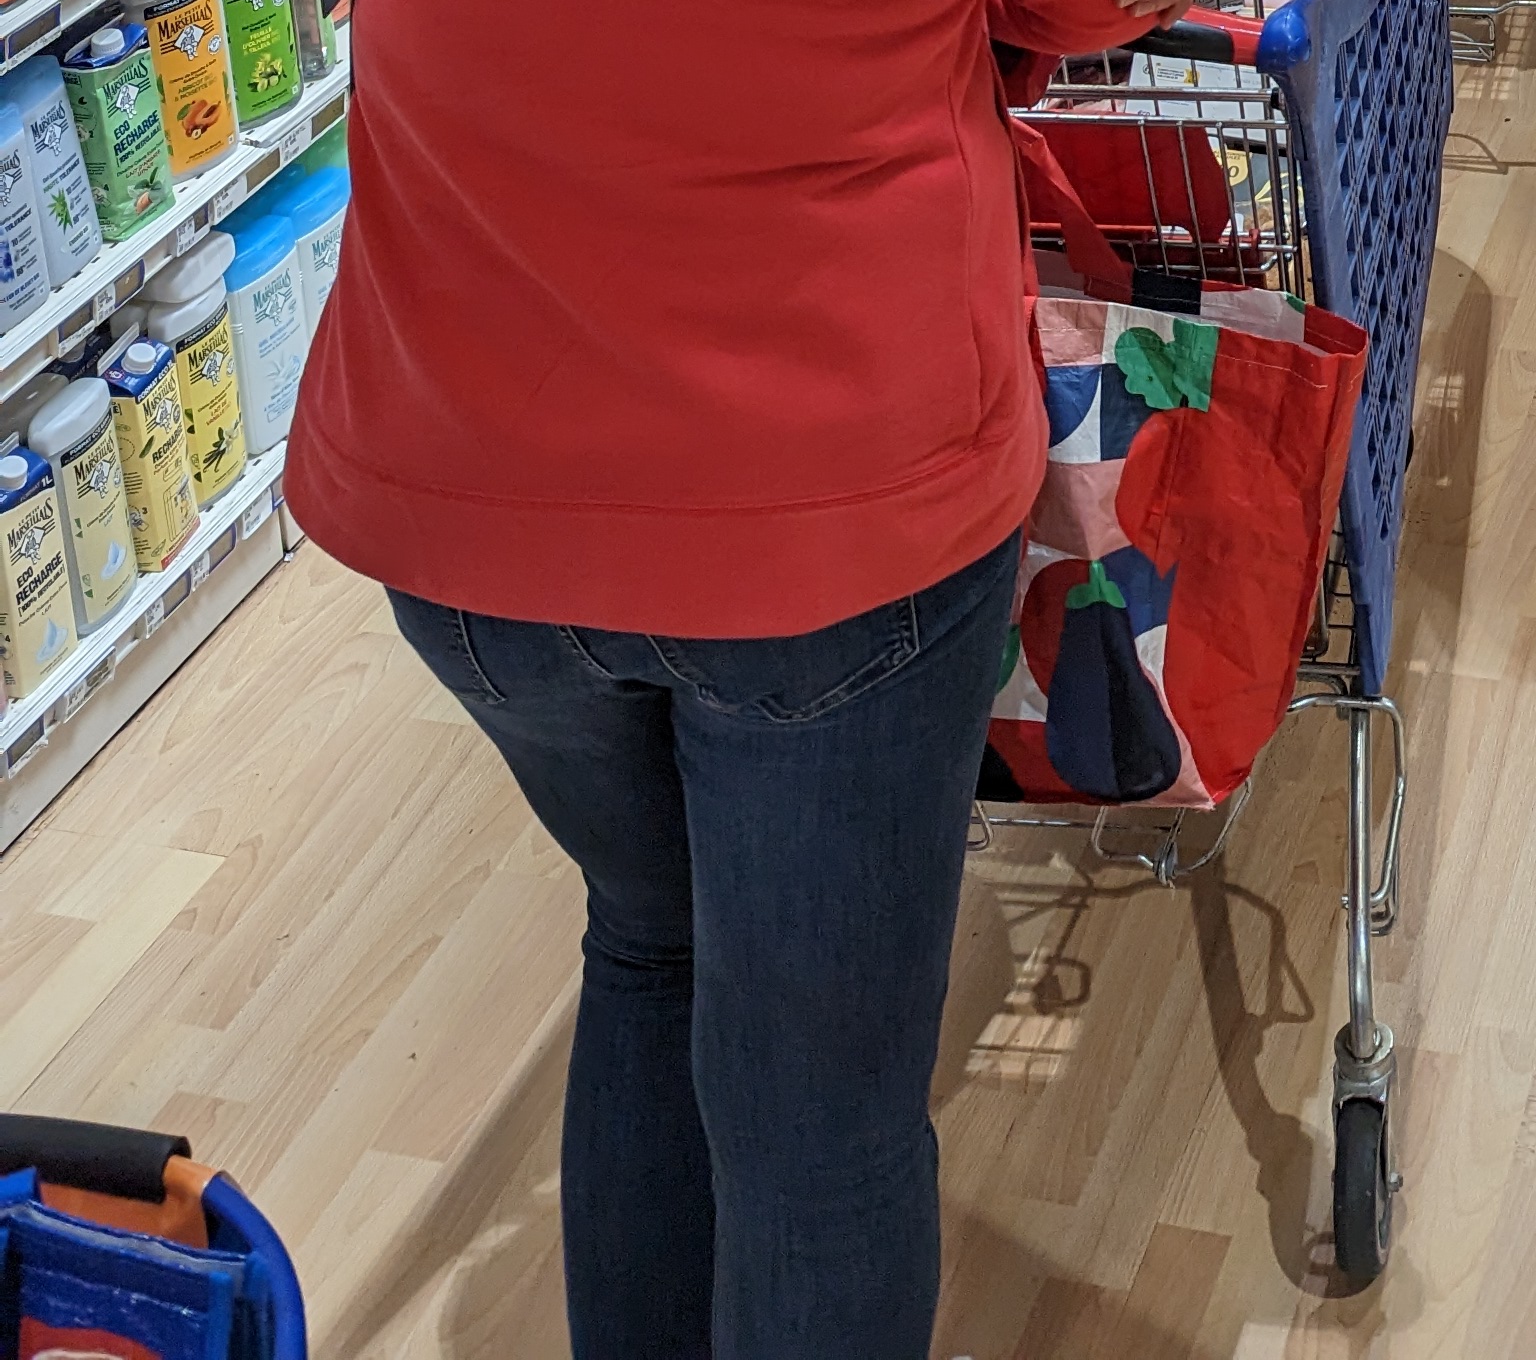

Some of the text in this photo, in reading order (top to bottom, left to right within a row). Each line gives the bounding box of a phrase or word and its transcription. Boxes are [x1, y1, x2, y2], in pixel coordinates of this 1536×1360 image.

[157, 0, 213, 42] MARSEILLAIS
[103, 57, 148, 104] MARSEILLAIS
[30, 100, 66, 143] MARSEILLAIS
[113, 119, 131, 140] ECO
[113, 109, 160, 156] RECHARGE
[254, 269, 290, 307] MARSEILLAIS
[184, 324, 206, 344] FORMAT
[187, 324, 228, 372] MARSEILLAIS
[137, 379, 158, 402] FORMAT
[143, 371, 177, 422] MARSEILLAIS
[69, 436, 91, 455] FORMAT
[74, 433, 114, 485] MARSEILLAIS
[152, 426, 183, 464] RECHARGE
[41, 476, 54, 488] 1L
[7, 497, 54, 553] MARSEILLAIS
[15, 551, 64, 605] RECHARGE
[17, 565, 34, 589] ECO
